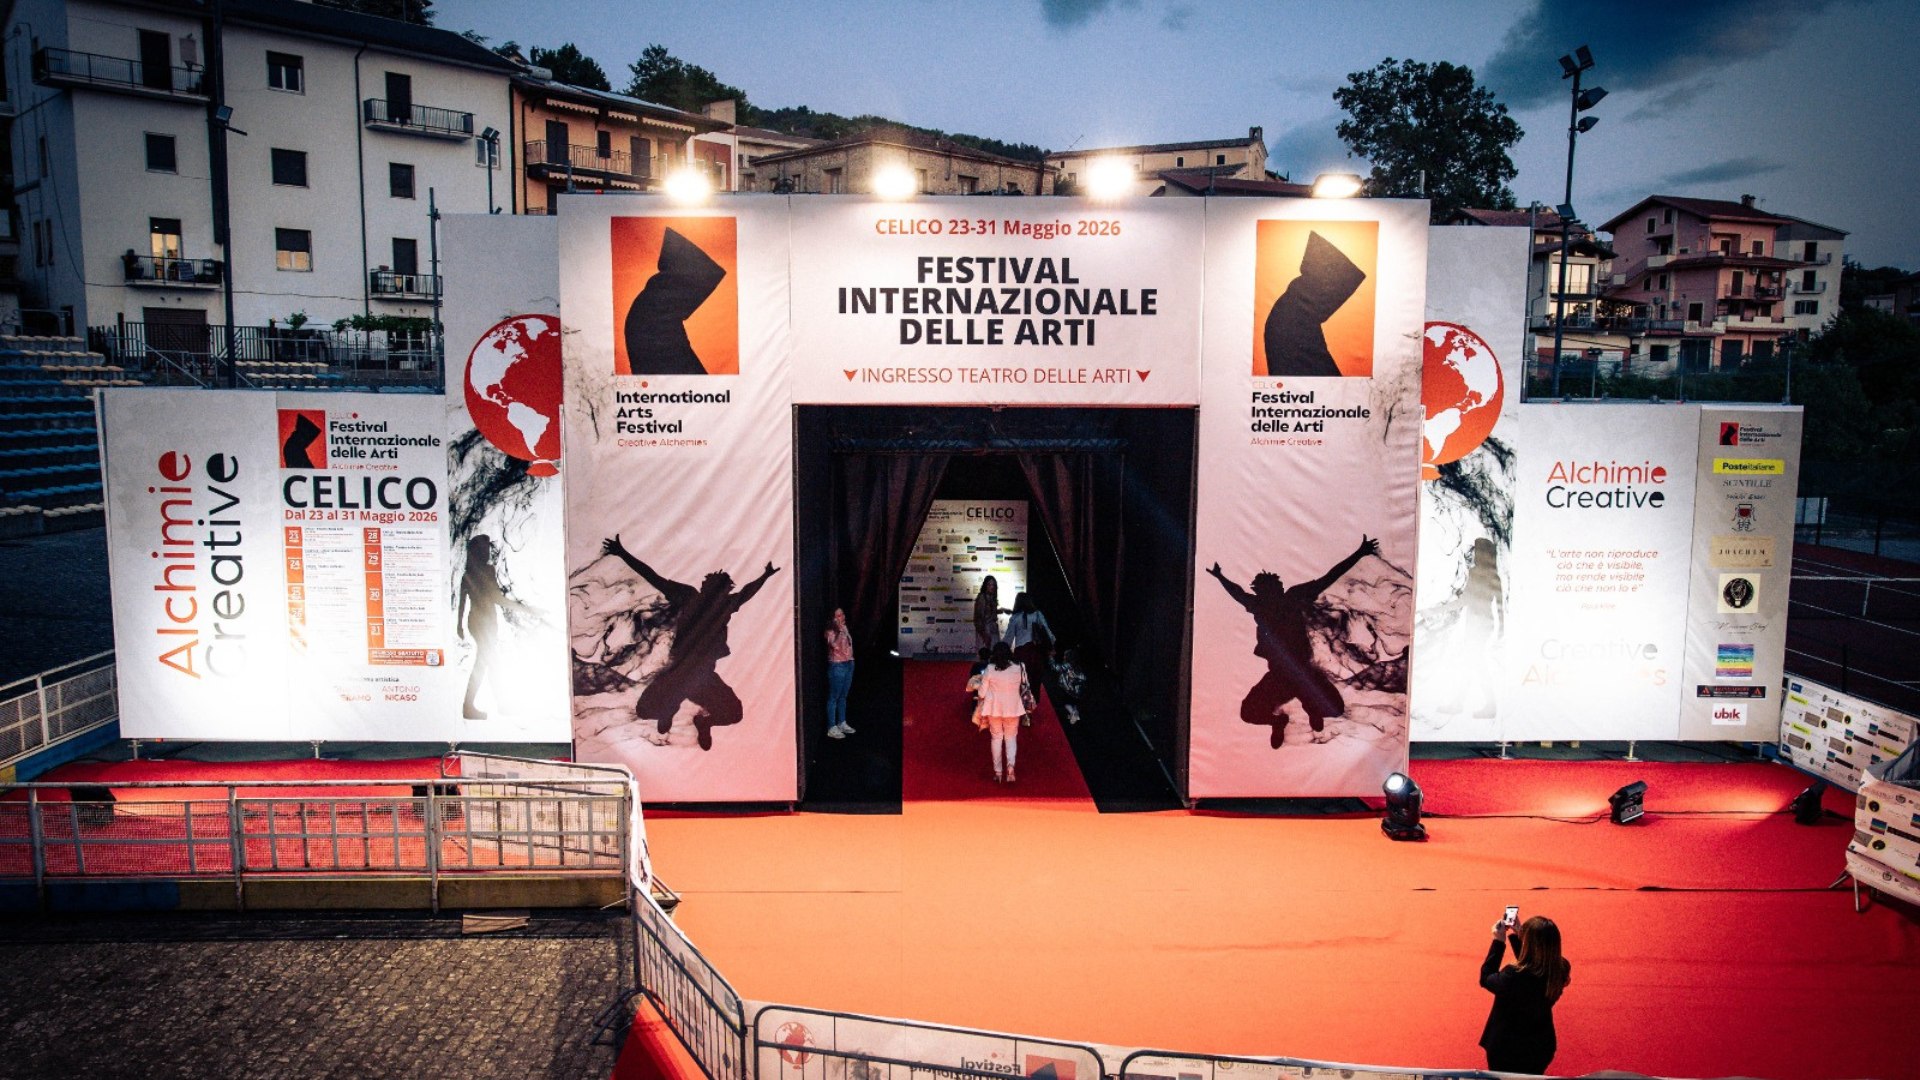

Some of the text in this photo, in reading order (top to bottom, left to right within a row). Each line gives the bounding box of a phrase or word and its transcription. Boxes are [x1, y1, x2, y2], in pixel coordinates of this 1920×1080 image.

[875, 219, 1121, 240] CELICO 23-31 Maggio 2026
[917, 256, 1080, 284] FESTIVAL
[838, 287, 1158, 316] INTERNAZIONALE
[900, 318, 1095, 346] DELLE ARTI
[862, 368, 1130, 384] INGRESSO TEATRO DELLE ARTI
[616, 390, 730, 404] International
[1252, 391, 1314, 404] Festival
[616, 407, 653, 418] Arts
[1252, 406, 1370, 418] Internazionale
[330, 421, 388, 432] Festival
[617, 420, 682, 434] Festival
[1251, 420, 1324, 432] delle Arti
[330, 434, 440, 447] Internazionale
[618, 438, 708, 447] Creative Alchemies
[331, 447, 398, 459] delle Arti
[1547, 460, 1667, 484] Alchimie
[283, 475, 438, 510] CELICO
[1546, 486, 1664, 508] Creative
[285, 510, 438, 524] Dal 23 al 31 Maggio 2026
[966, 507, 1015, 518] CELICO
[1608, 549, 1658, 560] riproduce
[149, 450, 200, 680] Alchimie
[198, 453, 248, 678] Creative
[1576, 561, 1594, 569] che
[1576, 572, 1606, 581] rende
[1610, 572, 1644, 581] visibile
[1575, 584, 1593, 592] che
[1541, 638, 1658, 660] Creative
[1714, 708, 1740, 719] ubik
